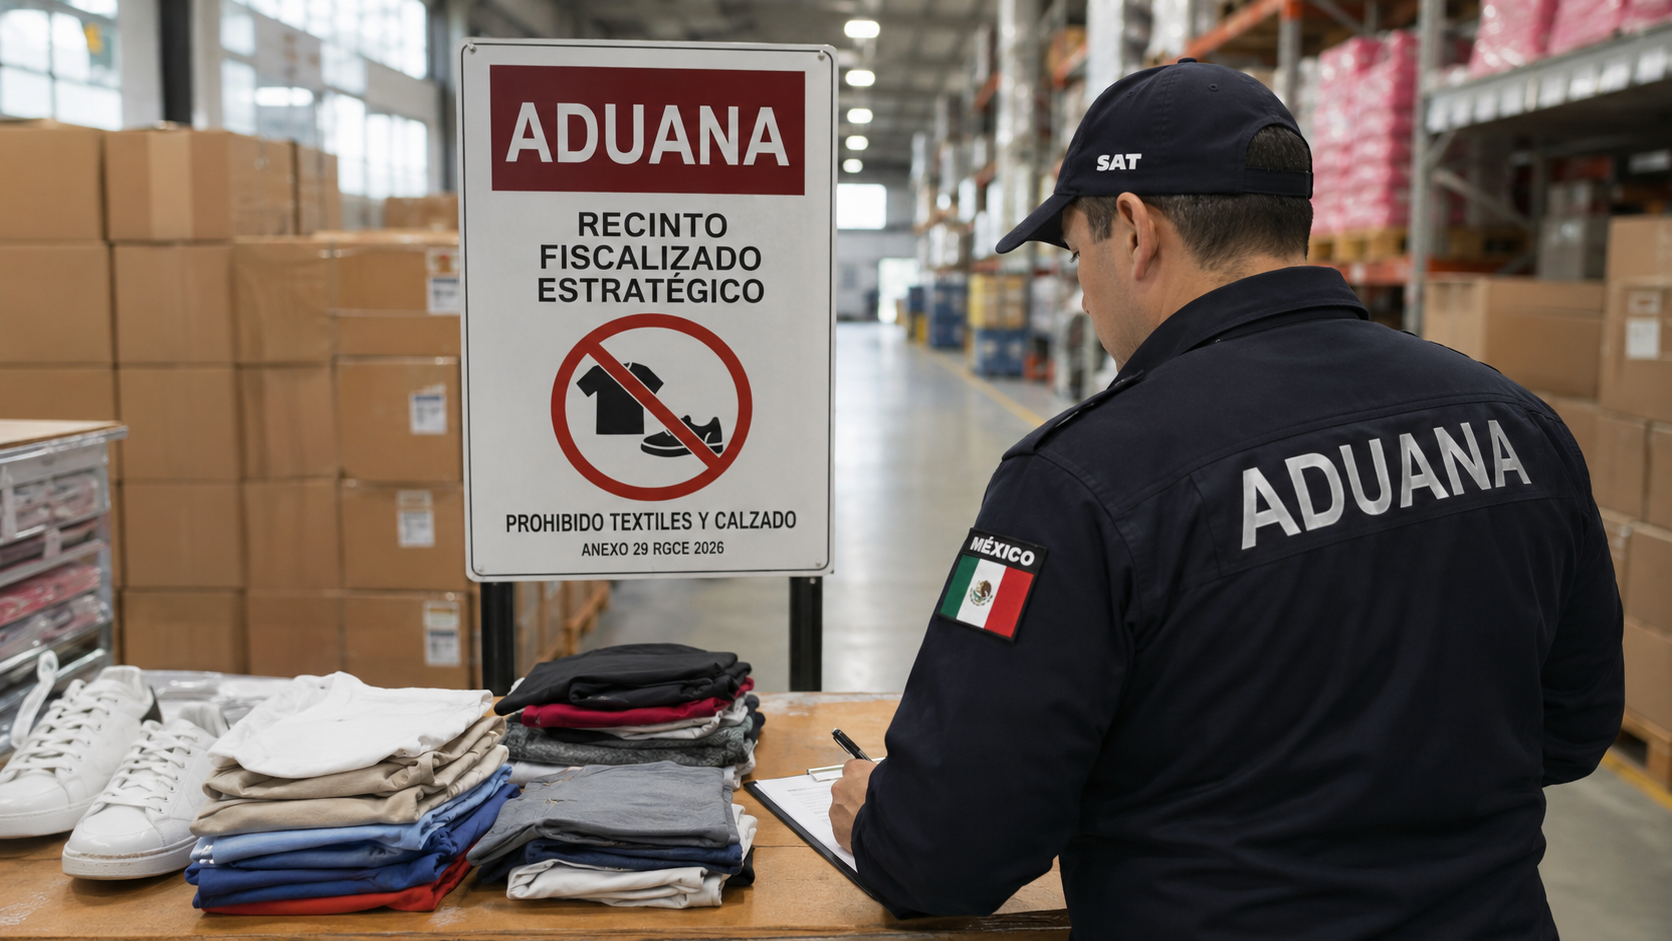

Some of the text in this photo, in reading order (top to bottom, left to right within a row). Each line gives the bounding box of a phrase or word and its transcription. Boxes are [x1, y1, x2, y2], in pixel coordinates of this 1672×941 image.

[506, 102, 790, 166] ADUANA
[1096, 153, 1142, 171] SAT
[578, 212, 728, 238] RECINTO
[540, 245, 762, 271] FISCALIZADO
[538, 273, 765, 304] ESTRATÉGICO
[1241, 419, 1532, 551] ADUANA
[506, 510, 797, 533] PROHIBIDO TEXTILES Y CALZADO
[581, 541, 724, 557] ANEXO 29 RGCE 2026
[970, 536, 1035, 566] MÉXICO
